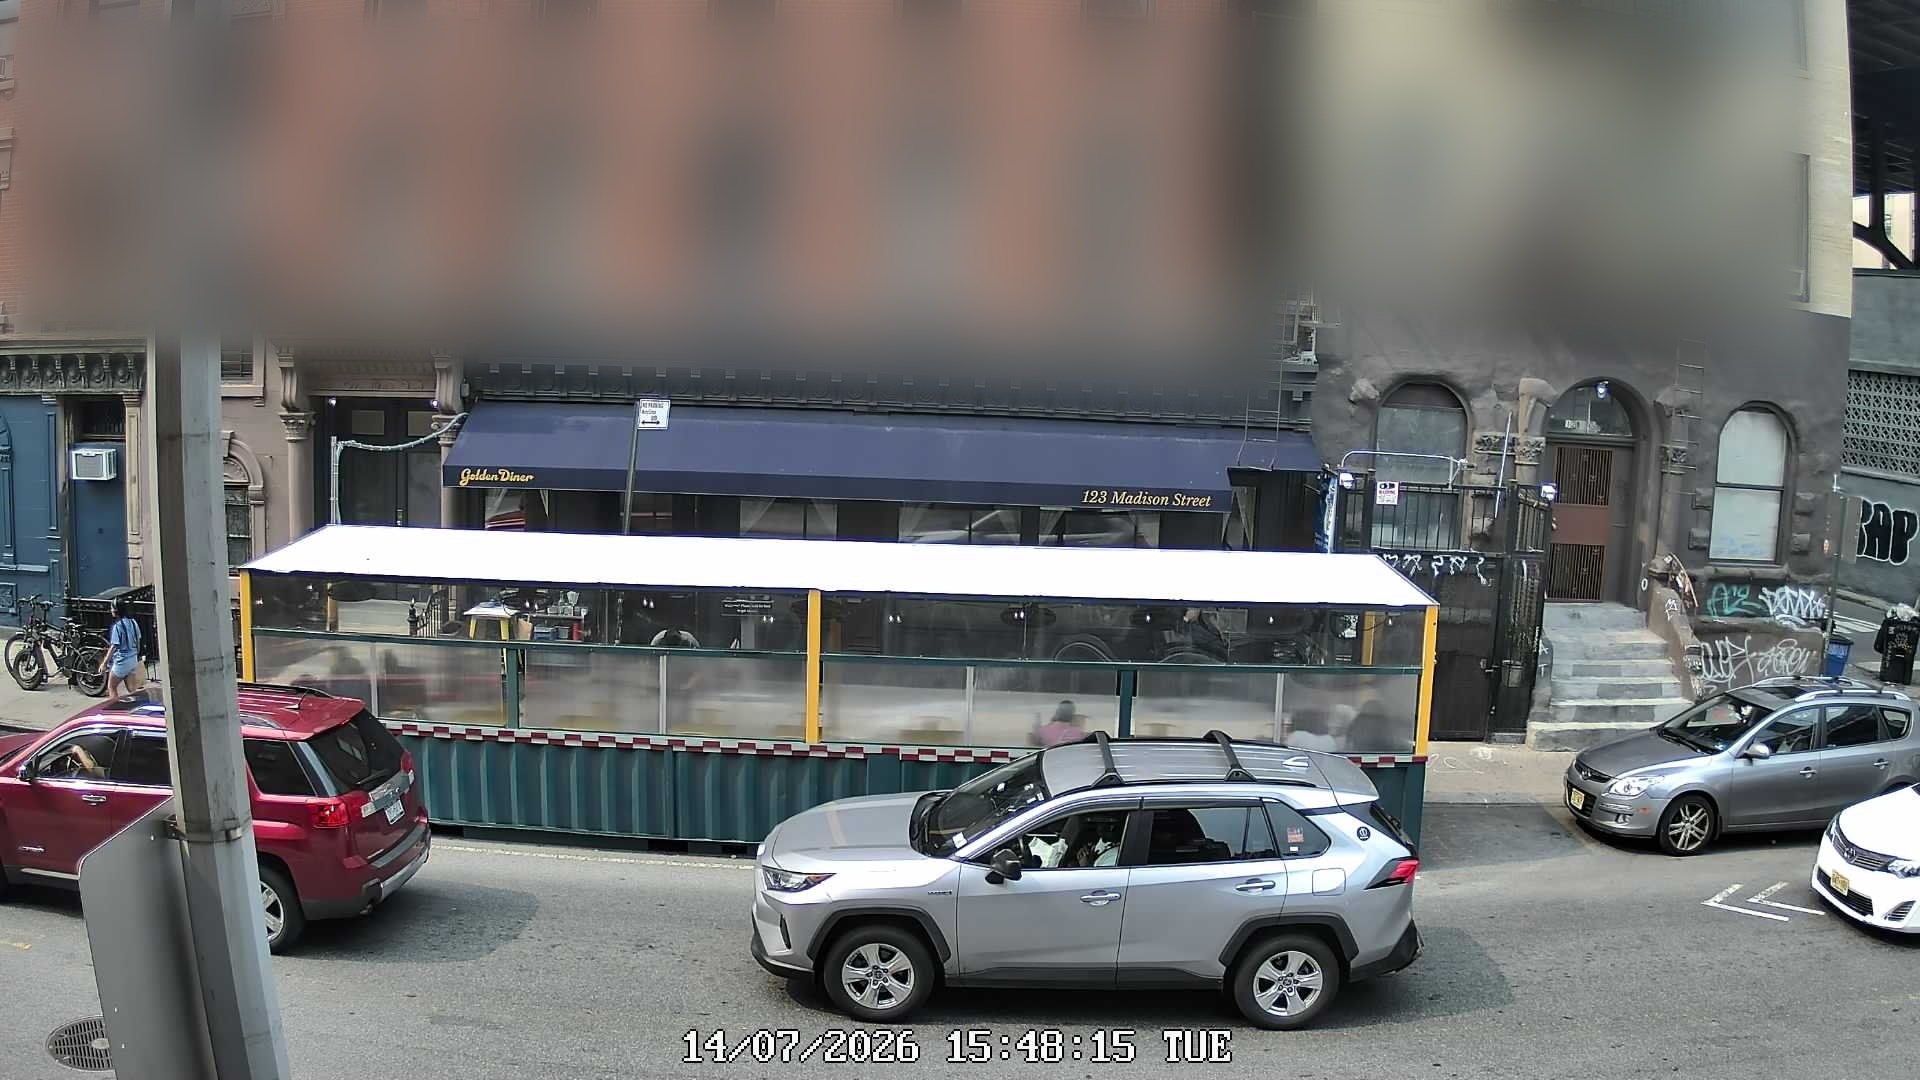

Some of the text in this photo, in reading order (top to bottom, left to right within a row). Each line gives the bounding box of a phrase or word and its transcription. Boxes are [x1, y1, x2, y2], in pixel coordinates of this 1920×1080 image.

[459, 468, 534, 486] Golden Diner
[1081, 490, 1212, 507] 123 Madison Street
